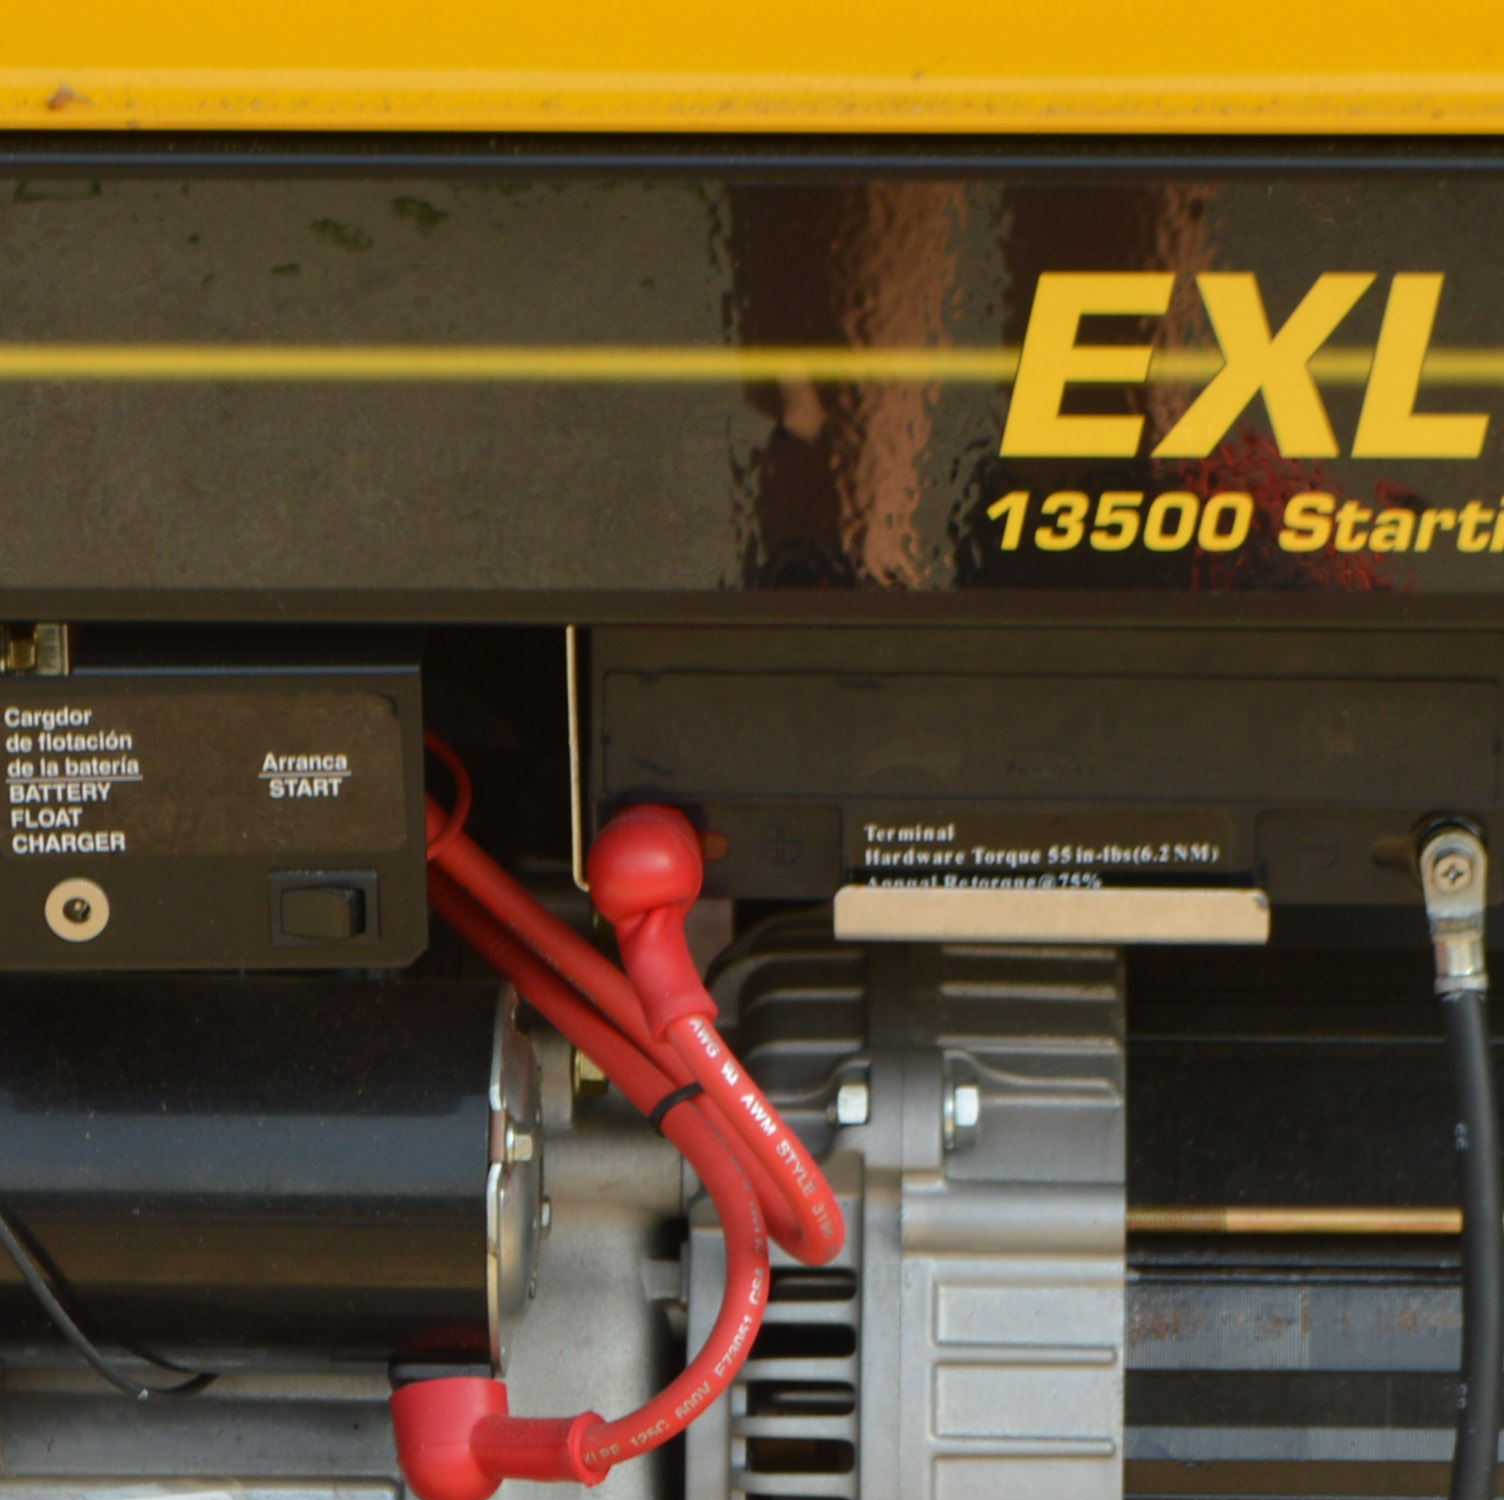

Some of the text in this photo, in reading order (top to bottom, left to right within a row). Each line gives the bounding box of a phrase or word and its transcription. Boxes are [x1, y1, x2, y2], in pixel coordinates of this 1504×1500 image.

[987, 490, 1254, 552] 13500
[4, 706, 92, 731] Cargdor
[6, 732, 33, 753] de
[7, 753, 140, 778] de la batería
[262, 751, 348, 772] Arranca
[10, 782, 111, 803] BATTERY
[269, 777, 344, 798] START
[11, 806, 83, 829] FLOAT
[12, 831, 126, 854] CHARGER
[864, 823, 955, 842] Terminal
[865, 849, 965, 867] Hardware
[971, 846, 1042, 869] Torque
[1047, 845, 1072, 865] 55
[689, 1018, 720, 1058] AWG
[741, 1093, 777, 1136] AWM
[777, 1139, 817, 1197] STYLE
[674, 1381, 711, 1419] 600V
